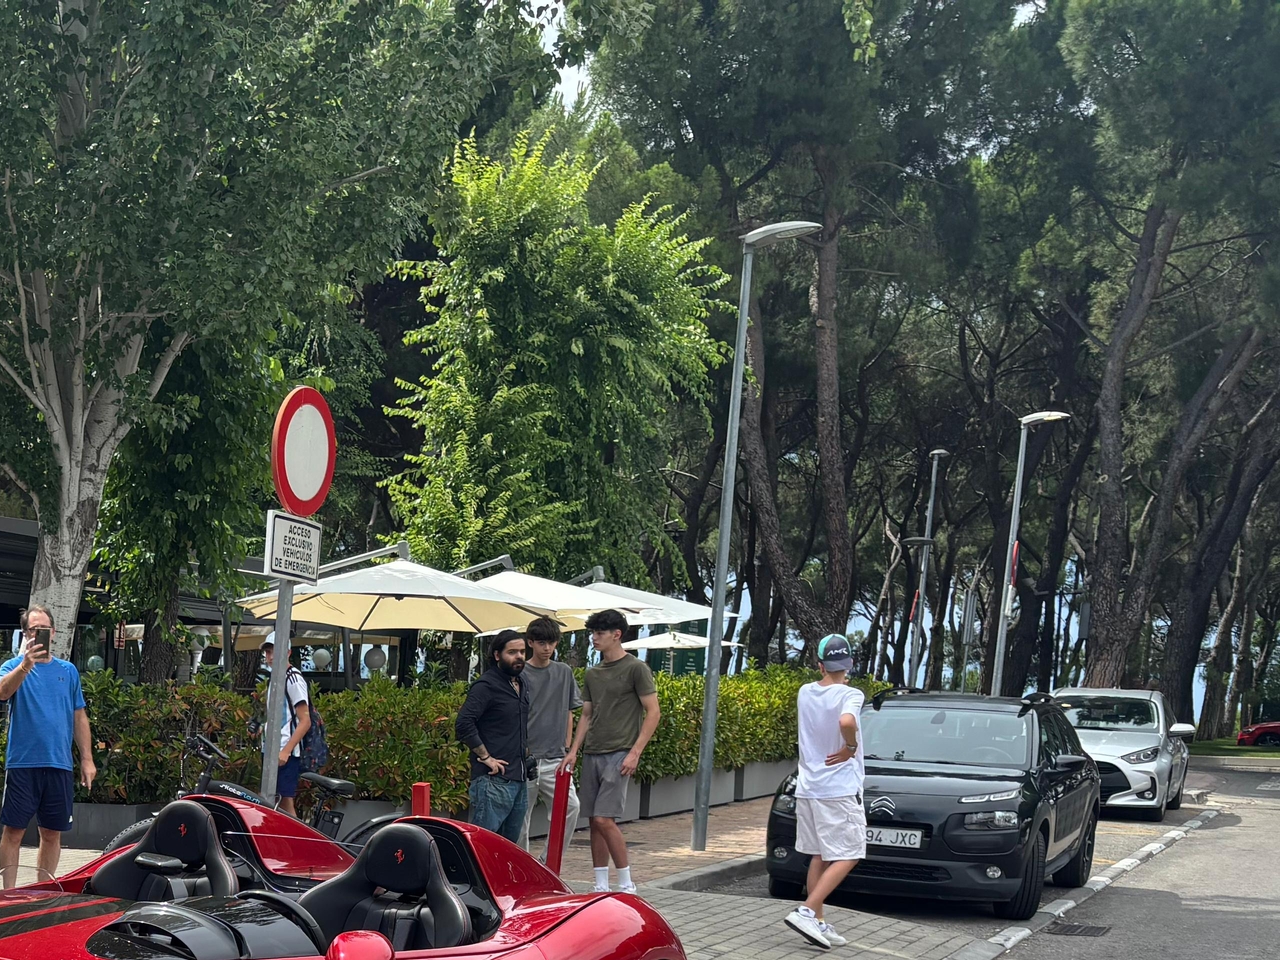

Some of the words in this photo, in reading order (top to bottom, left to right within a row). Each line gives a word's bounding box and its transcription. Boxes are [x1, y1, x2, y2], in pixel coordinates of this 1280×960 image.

[288, 524, 311, 539] ACCESO
[283, 535, 313, 551] EXCLUSIVO
[275, 557, 283, 568] DE
[284, 559, 315, 575] EMERGENCIA
[890, 832, 918, 846] JXC
